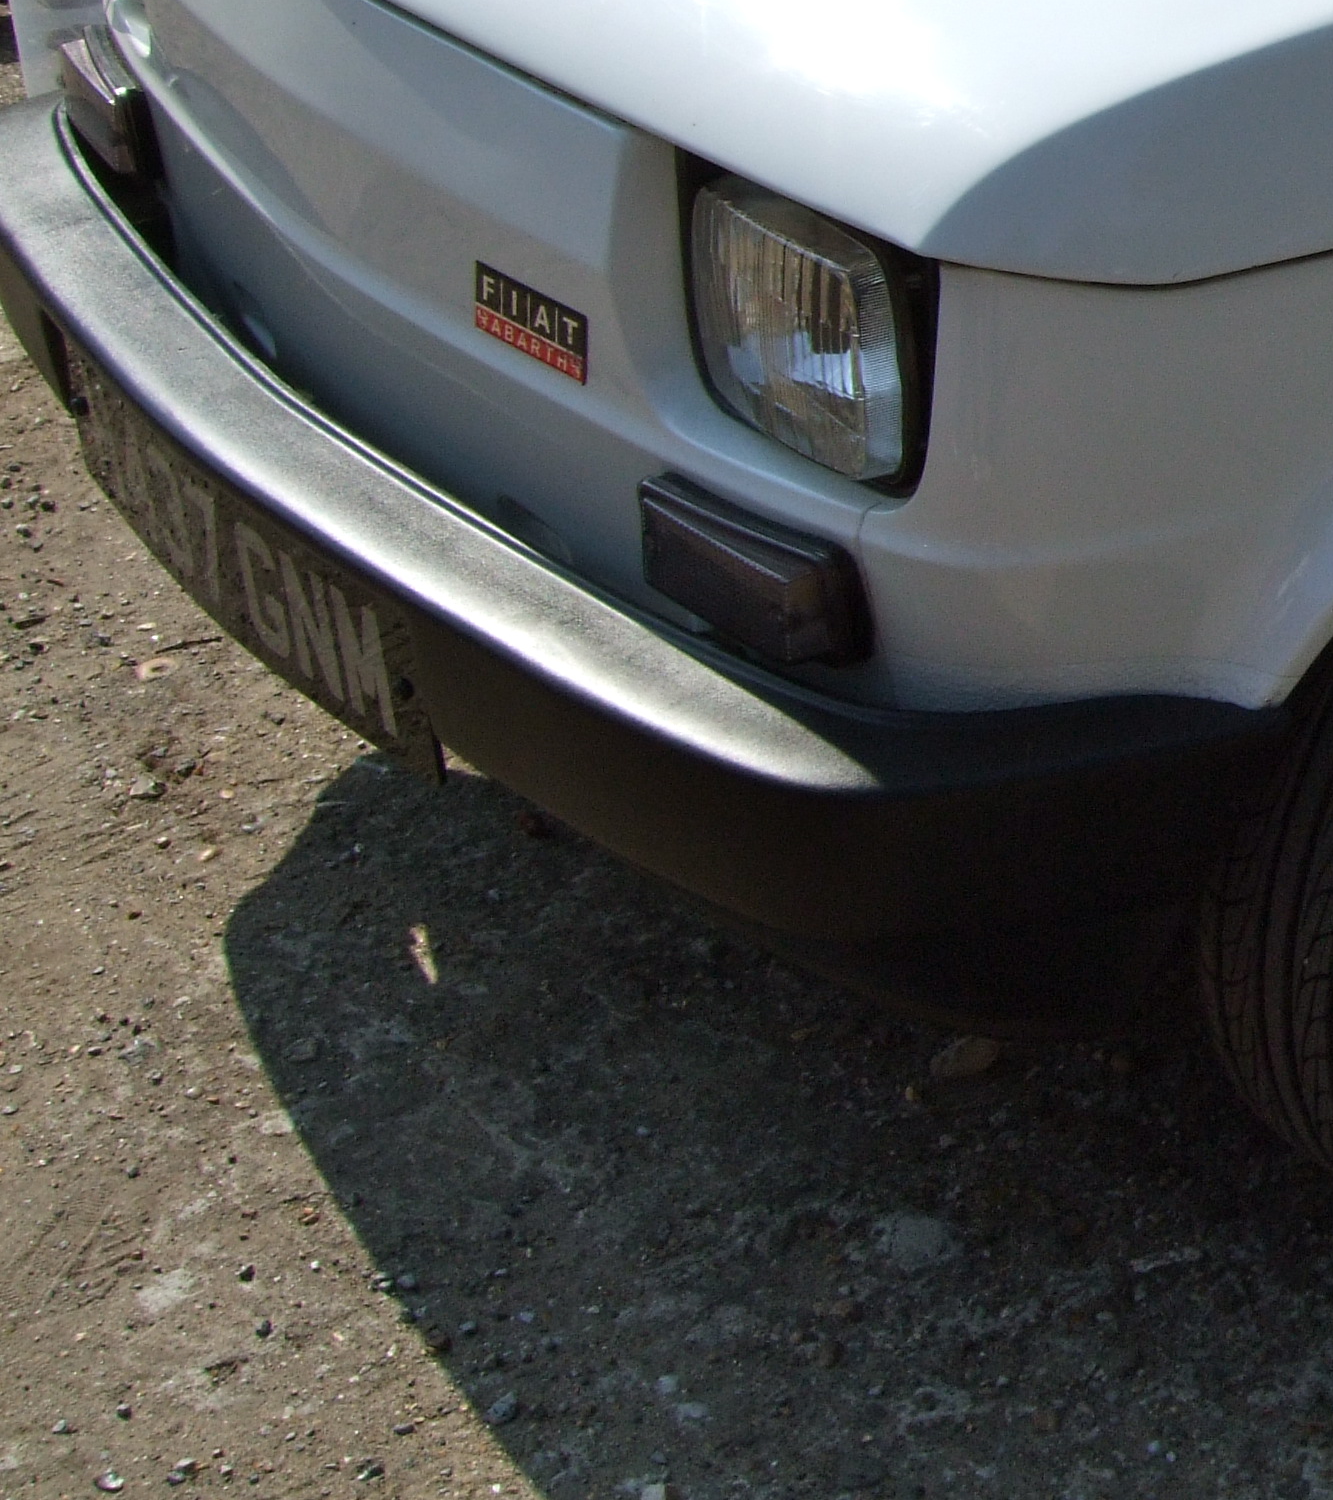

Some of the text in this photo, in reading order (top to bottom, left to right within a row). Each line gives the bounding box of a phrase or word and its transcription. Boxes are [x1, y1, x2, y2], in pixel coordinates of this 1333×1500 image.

[482, 275, 579, 345] FIAT
[491, 318, 567, 372] ABARTH
[233, 520, 400, 741] GNM
